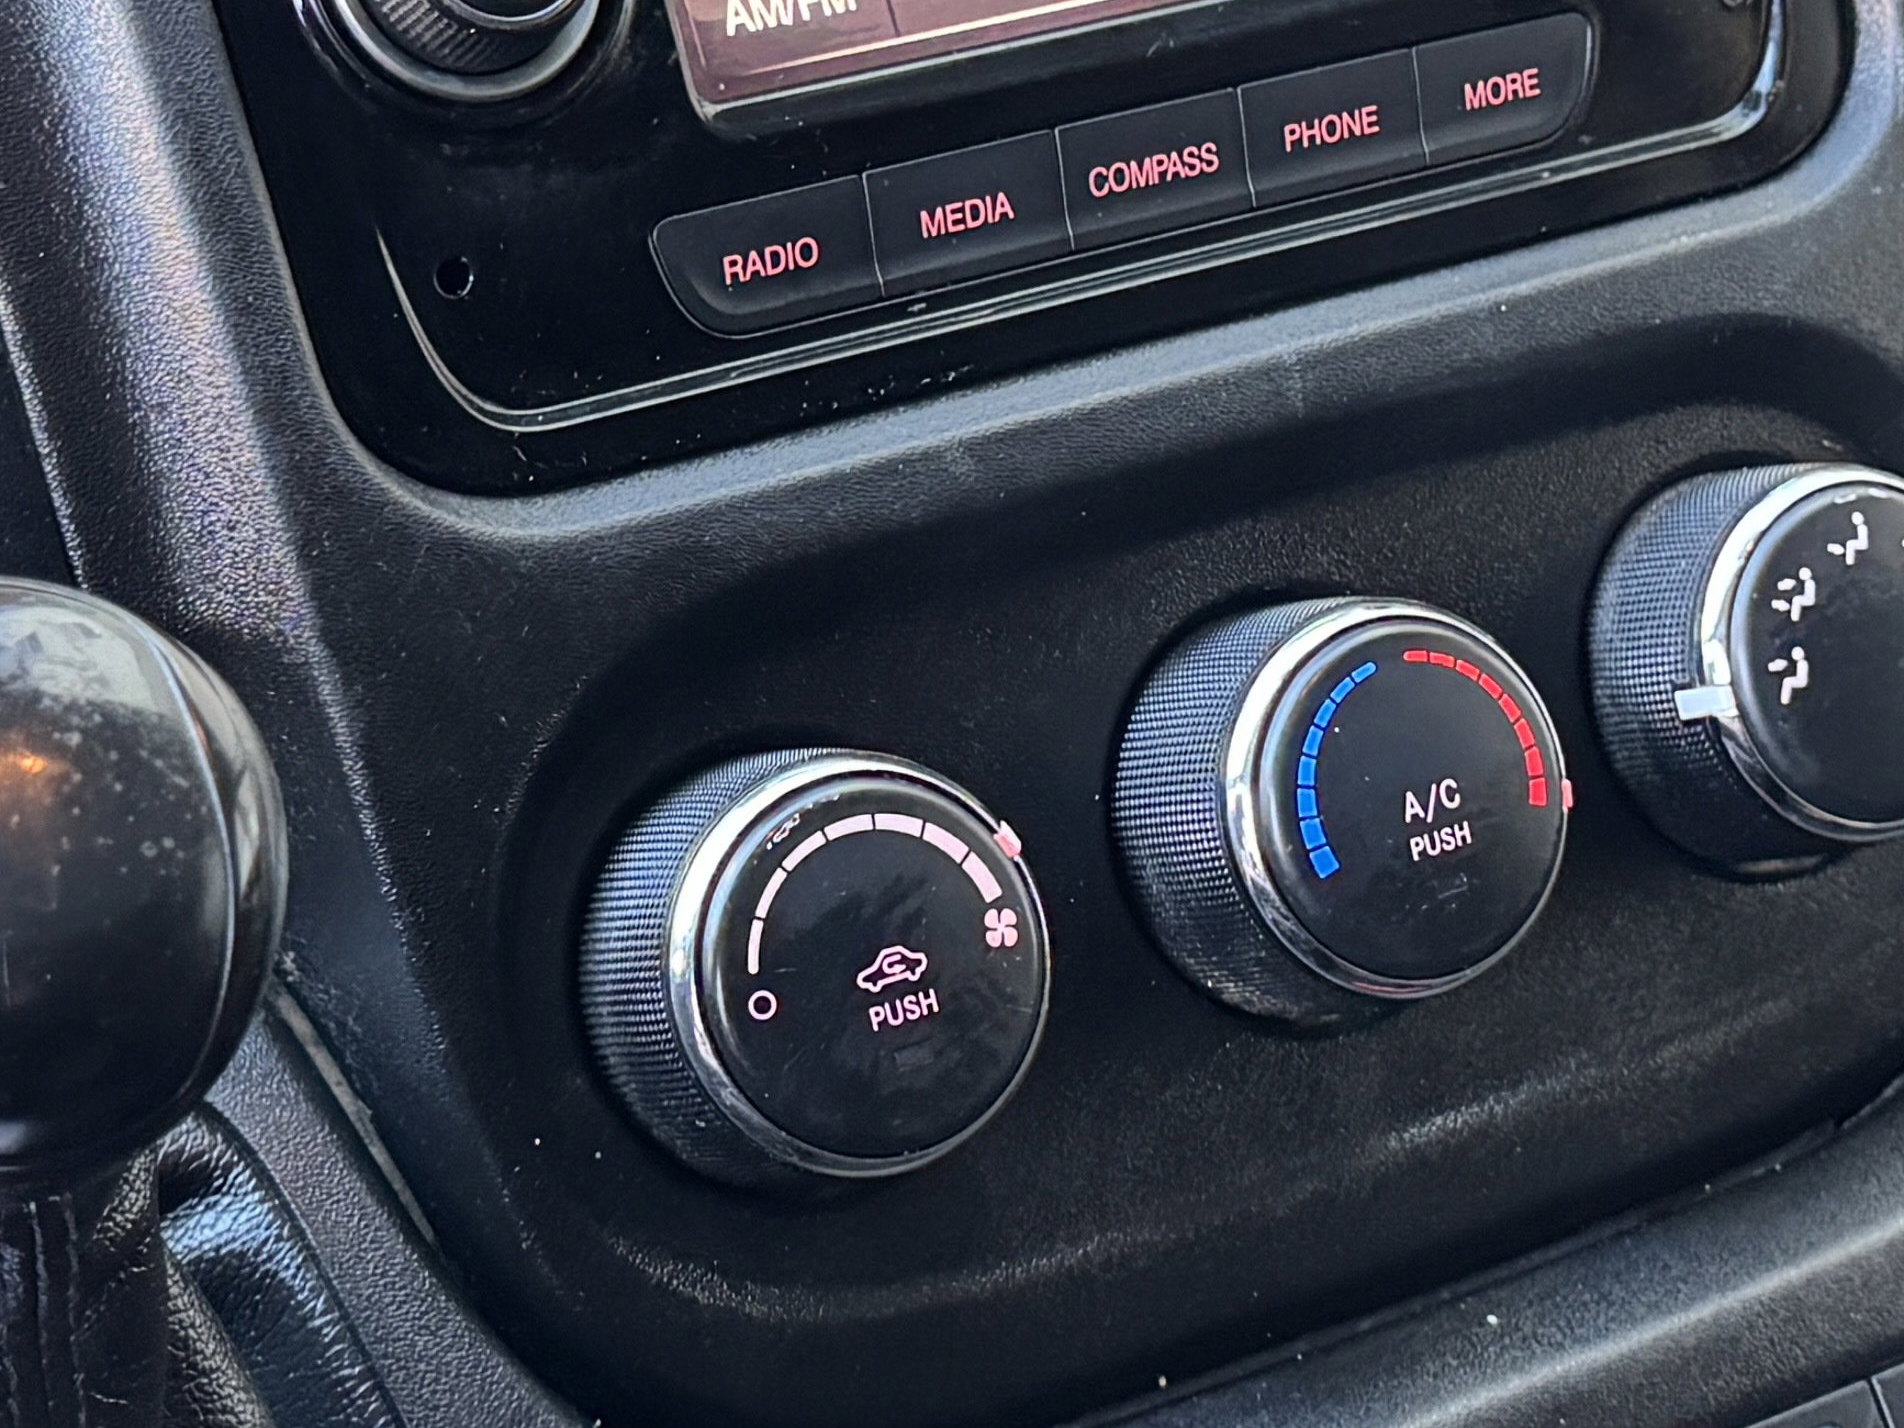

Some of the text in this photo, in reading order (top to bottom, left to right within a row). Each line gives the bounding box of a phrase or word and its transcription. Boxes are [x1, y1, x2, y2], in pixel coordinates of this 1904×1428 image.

[1464, 67, 1541, 111] MORE
[1283, 105, 1380, 153] PHONE
[1088, 142, 1220, 198] COMPASS
[920, 191, 1015, 239] MEDIA
[722, 236, 819, 285] RADIO
[1404, 778, 1461, 824] A/C
[1409, 820, 1473, 862] PUSH
[868, 987, 940, 1032] PUSH
